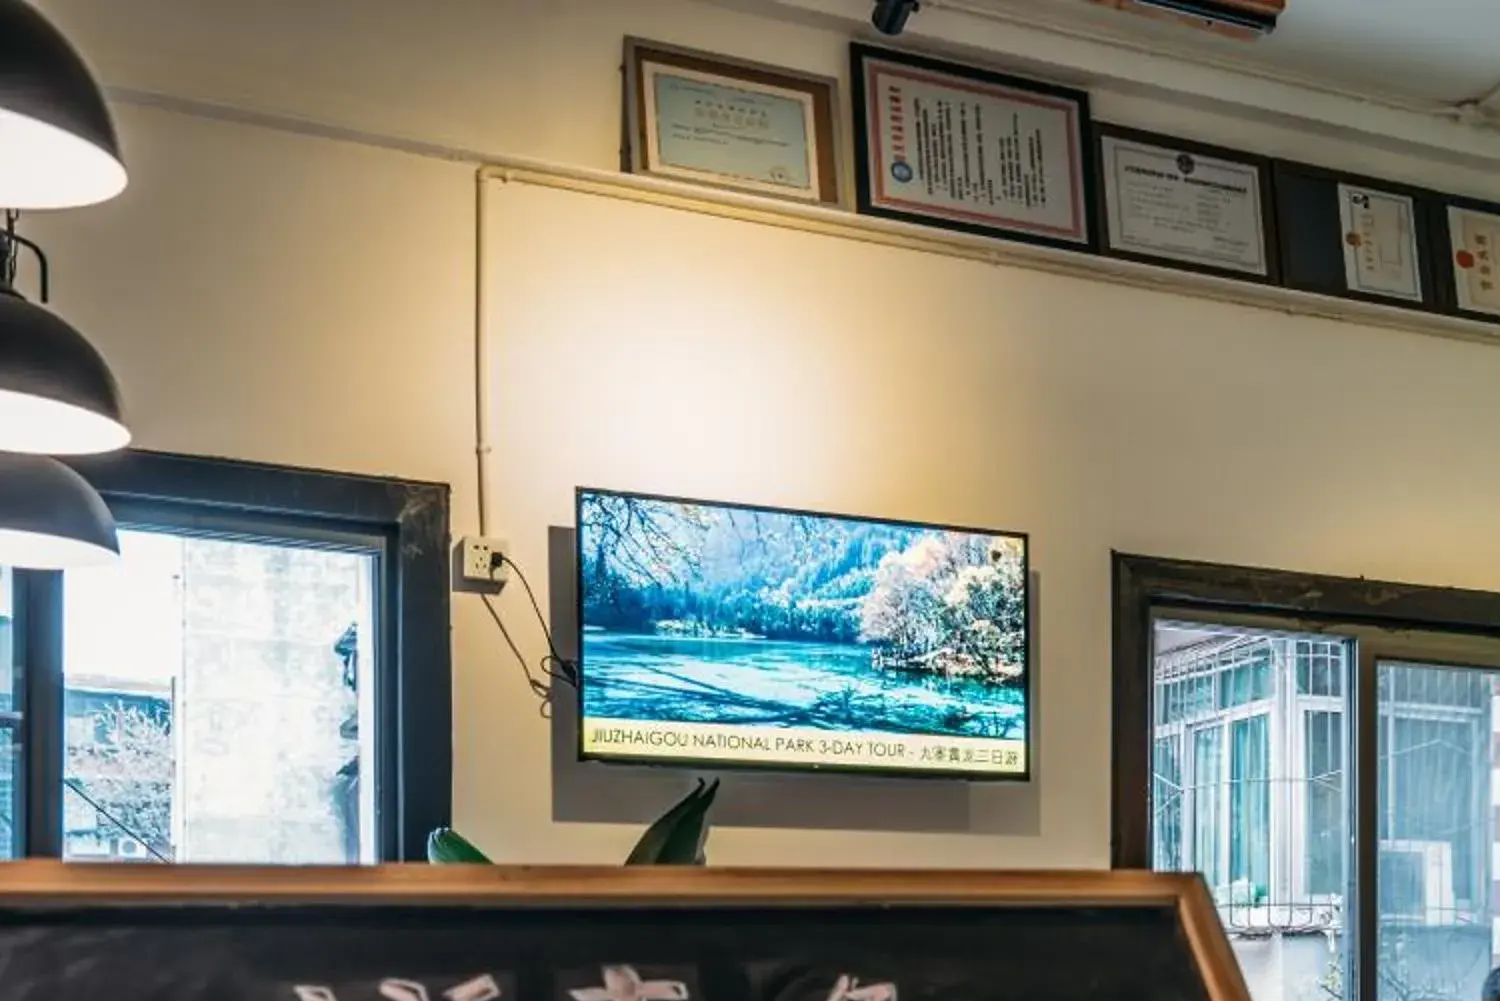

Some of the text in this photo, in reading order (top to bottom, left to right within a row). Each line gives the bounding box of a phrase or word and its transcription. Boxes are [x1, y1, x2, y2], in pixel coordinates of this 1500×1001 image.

[592, 727, 688, 747] JIUZHAIGOU
[693, 732, 771, 751] NATIONAL
[775, 737, 814, 753] PARK
[818, 739, 863, 755] 3-DAY
[868, 741, 905, 758] TOUR
